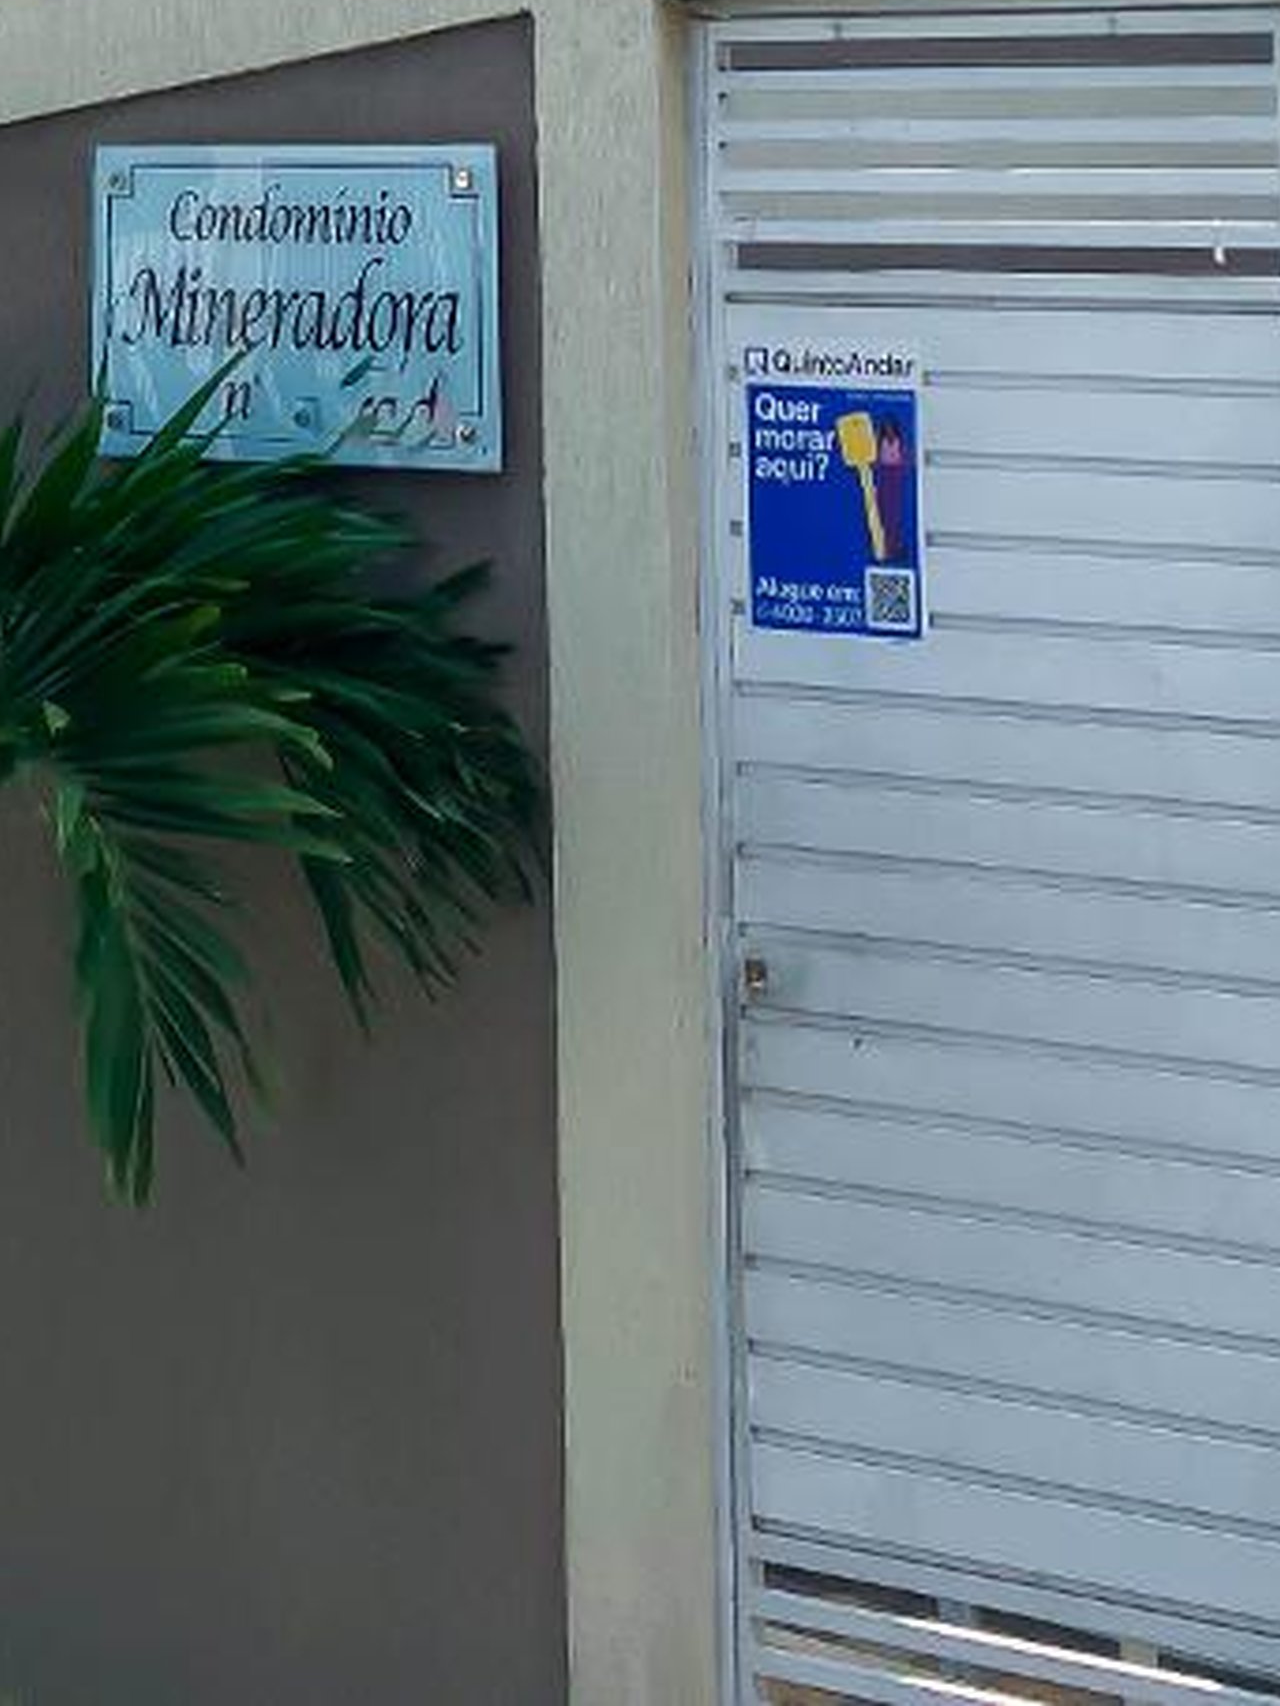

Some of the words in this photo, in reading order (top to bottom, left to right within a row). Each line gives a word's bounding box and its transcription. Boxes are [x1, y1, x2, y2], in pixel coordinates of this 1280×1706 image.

[122, 257, 462, 373] Mineradora
[755, 392, 821, 423] Quer
[755, 429, 835, 450] morar
[755, 453, 828, 484] aqui?
